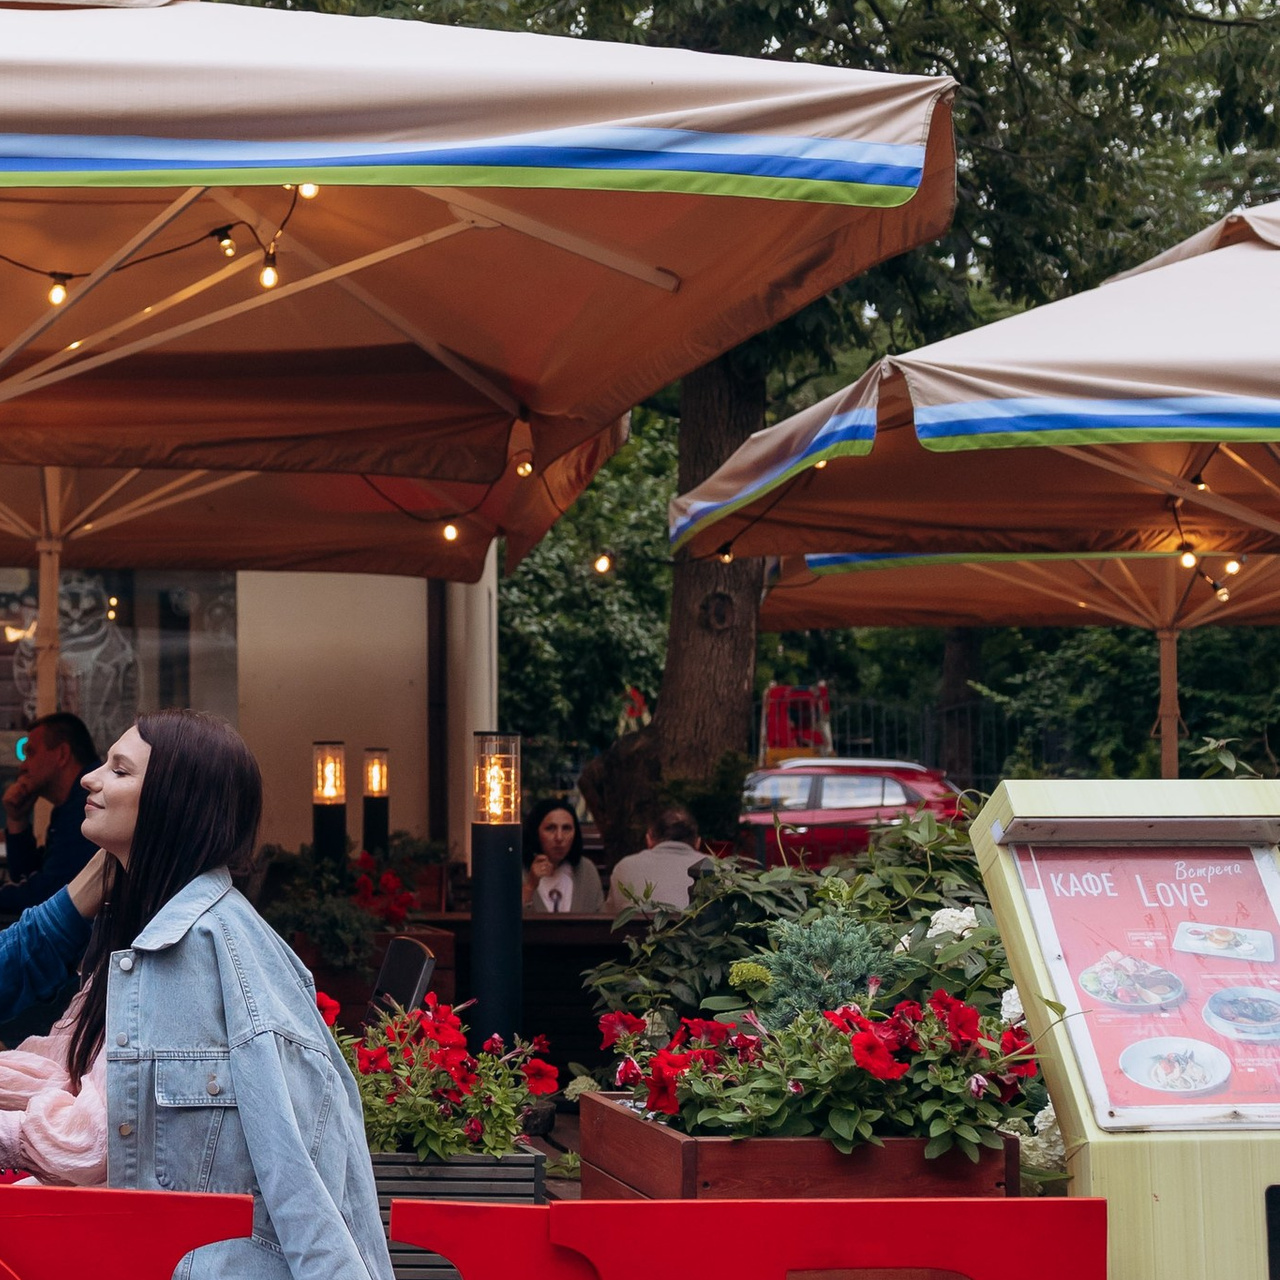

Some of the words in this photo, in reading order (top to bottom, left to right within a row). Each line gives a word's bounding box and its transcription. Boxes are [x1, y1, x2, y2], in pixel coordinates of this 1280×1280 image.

[1175, 861, 1242, 883] Встреча
[1050, 872, 1118, 897] КАФЕ
[1135, 874, 1209, 907] Love
